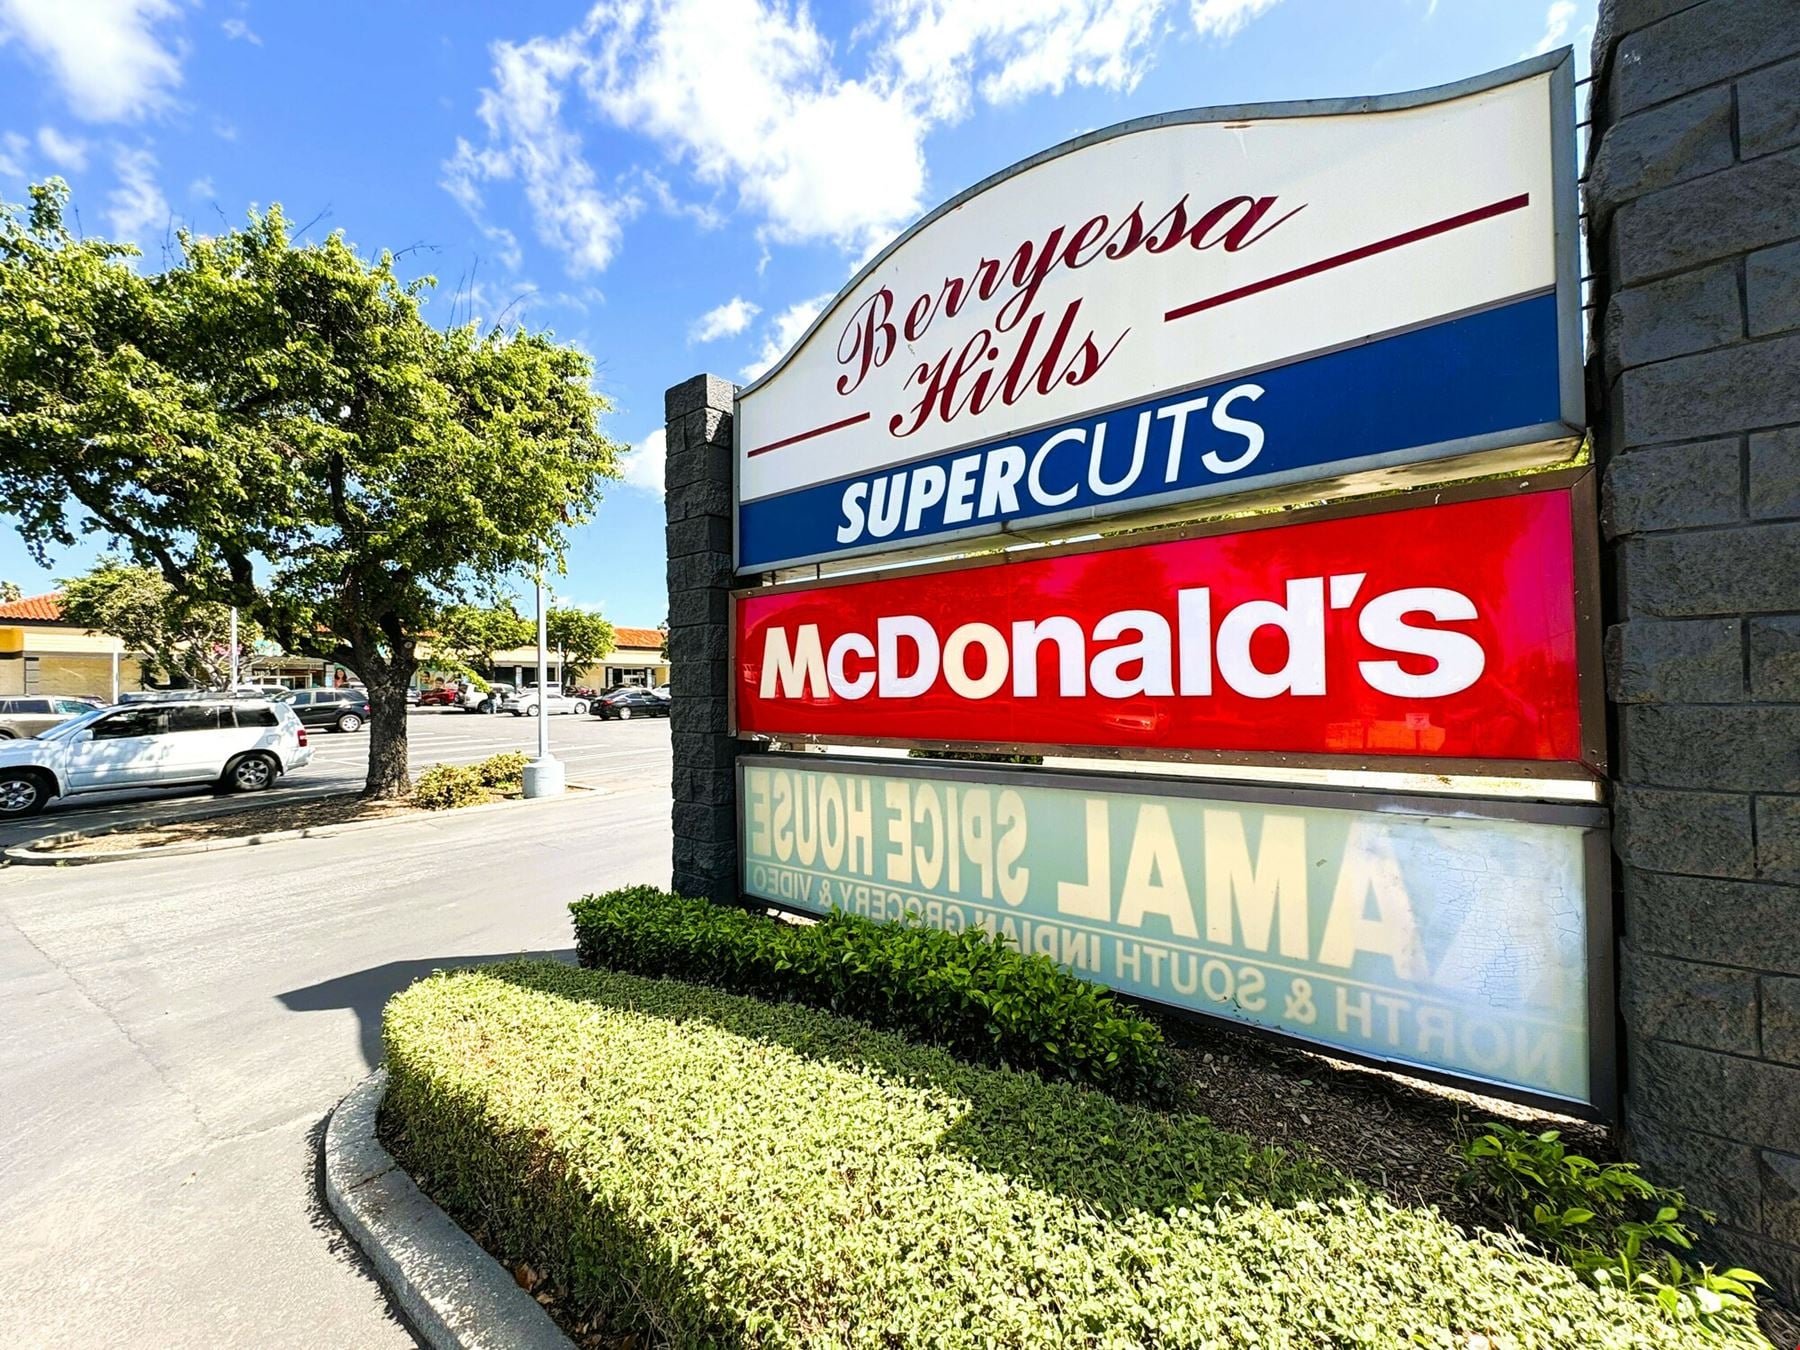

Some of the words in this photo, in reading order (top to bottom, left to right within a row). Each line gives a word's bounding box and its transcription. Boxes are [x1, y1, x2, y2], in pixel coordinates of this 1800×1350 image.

[837, 195, 1307, 396] Berryessa
[889, 297, 1131, 438] Hills
[836, 383, 1265, 543] SUPERCUTS
[758, 572, 1486, 700] McDonald's
